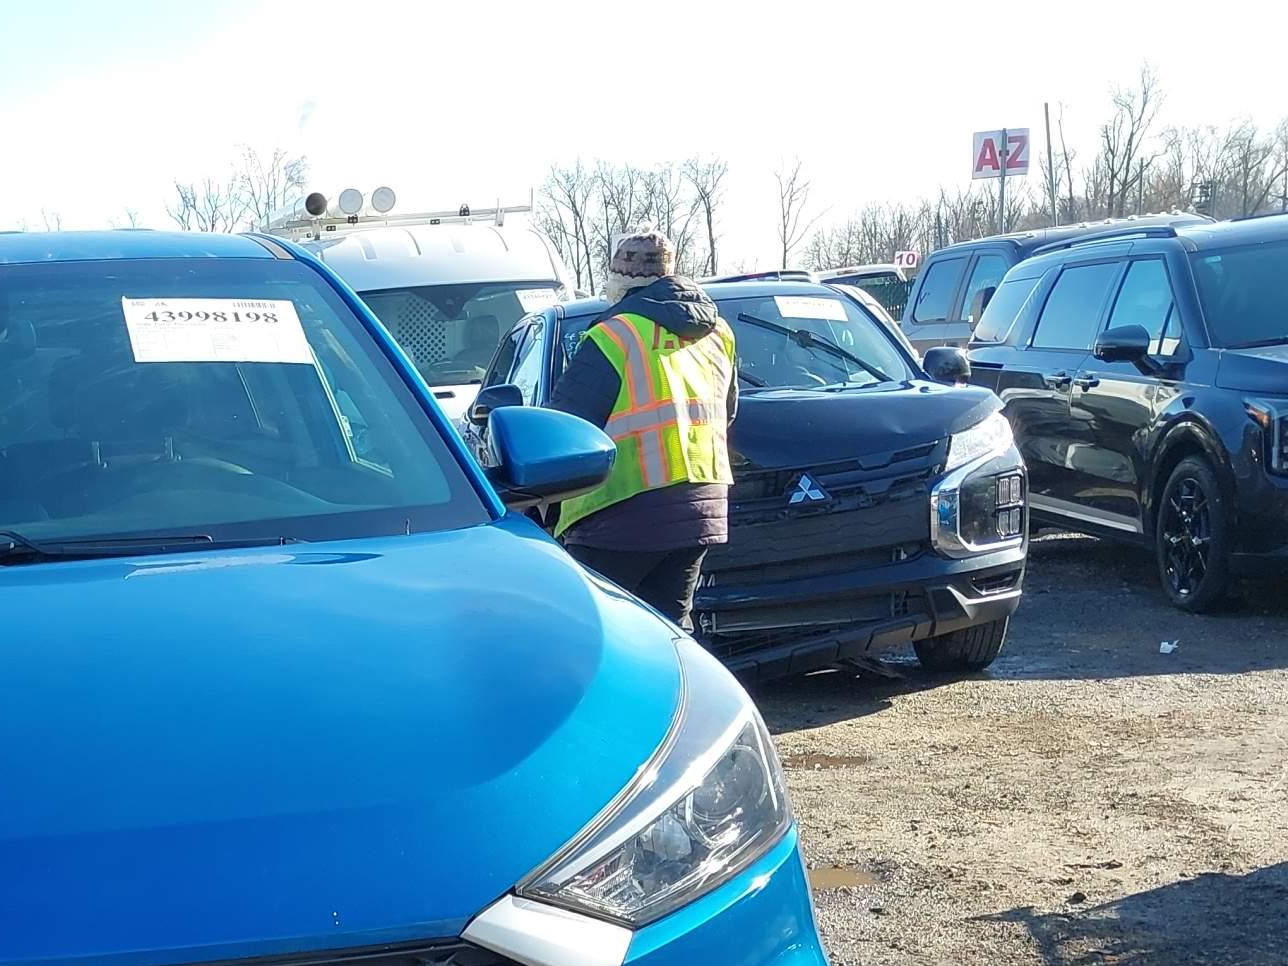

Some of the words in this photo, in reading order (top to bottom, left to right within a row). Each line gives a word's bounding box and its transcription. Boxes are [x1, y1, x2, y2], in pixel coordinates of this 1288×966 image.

[975, 138, 1000, 172] A
[1006, 135, 1029, 169] Z
[896, 253, 916, 266] 10
[144, 310, 278, 323] 43998198
